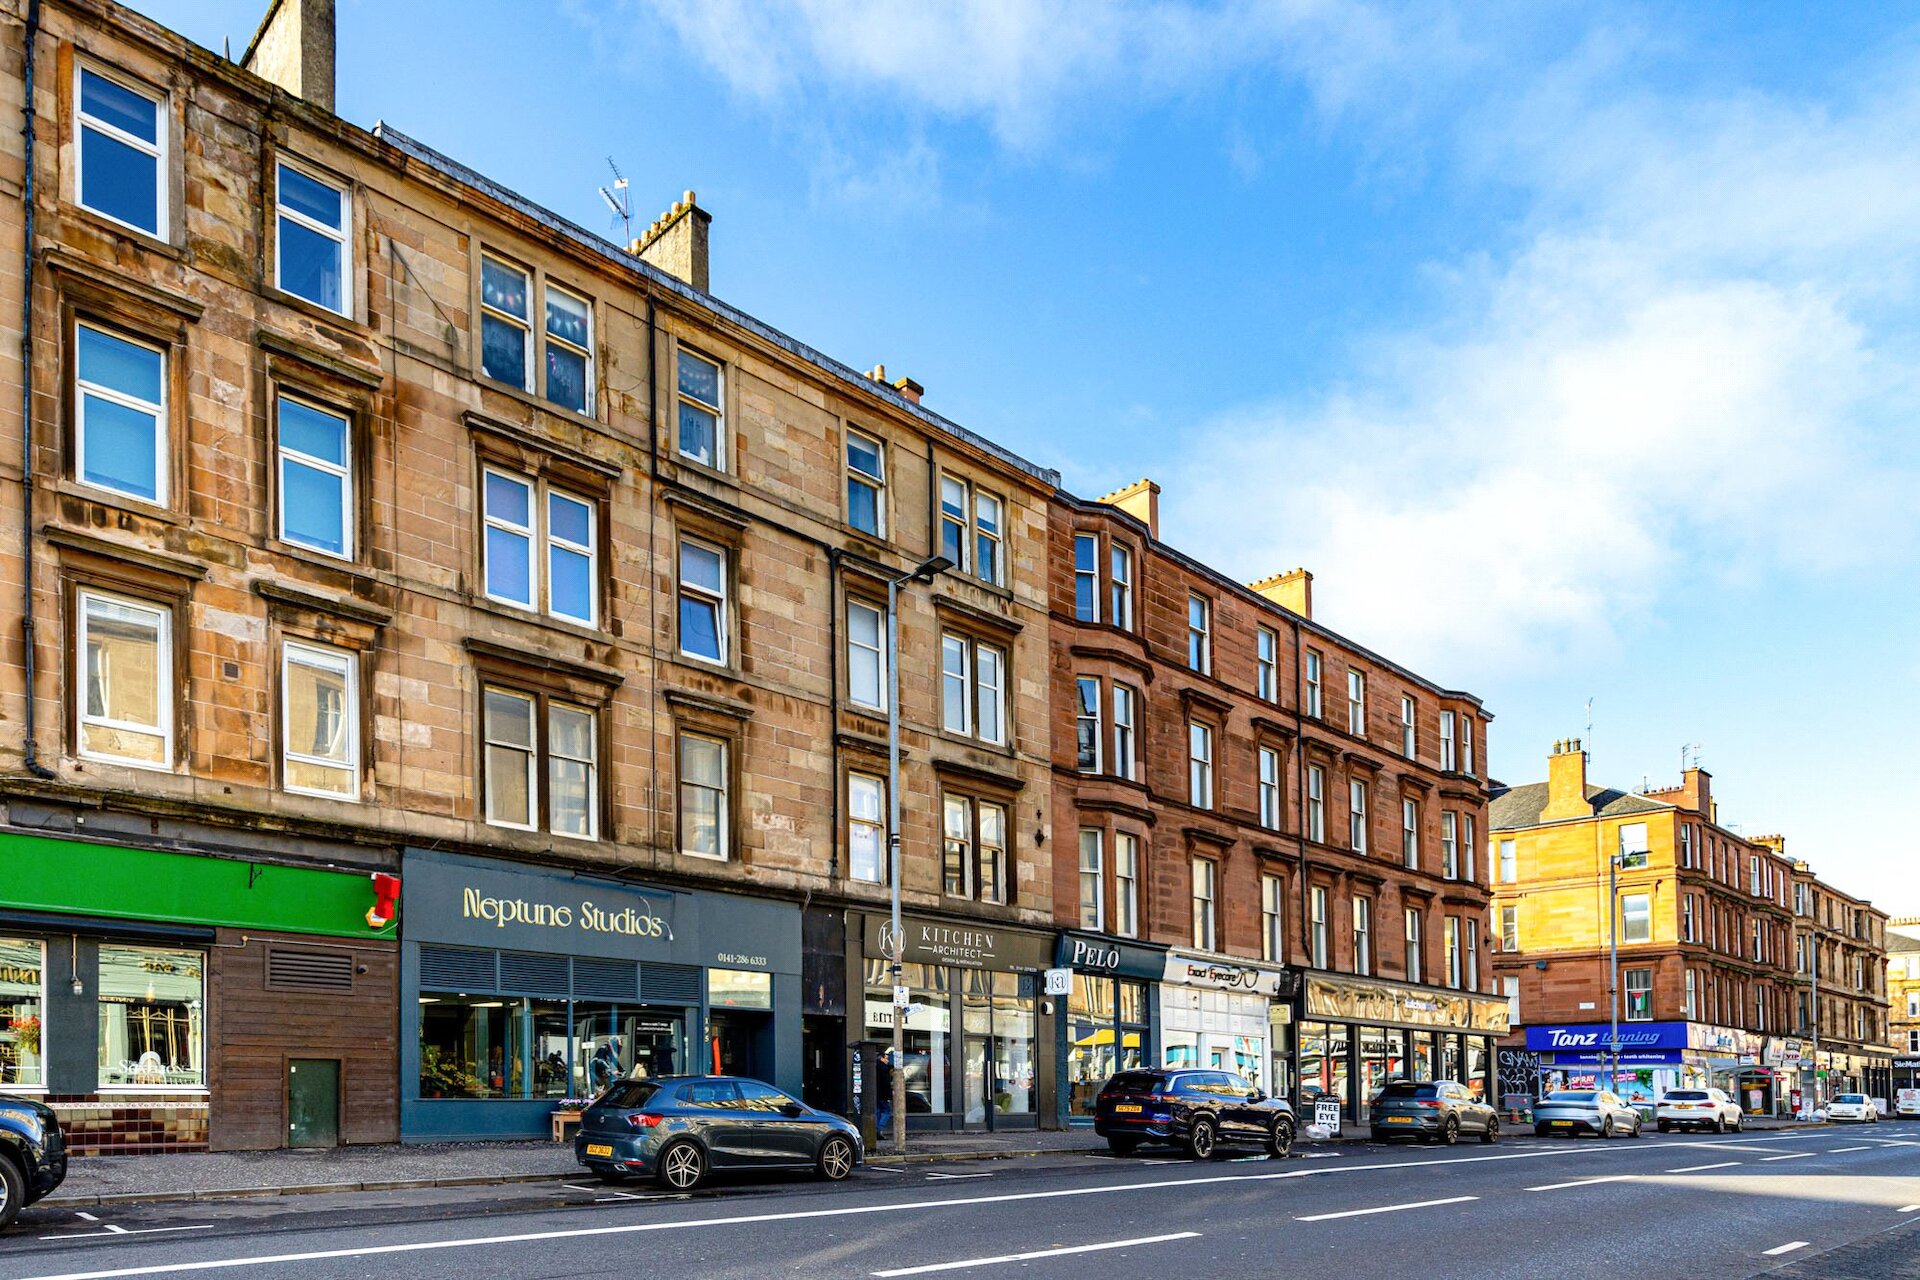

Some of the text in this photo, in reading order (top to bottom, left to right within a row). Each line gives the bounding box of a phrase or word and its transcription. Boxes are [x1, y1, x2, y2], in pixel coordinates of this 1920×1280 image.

[463, 887, 664, 937] Neptune Studios
[922, 926, 994, 948] KITCHEN
[932, 945, 982, 959] ARCHITECT
[1072, 940, 1120, 969] PELO
[1547, 1029, 1598, 1047] Tanz
[1316, 1103, 1339, 1112] FREE
[1319, 1113, 1336, 1121] EYE
